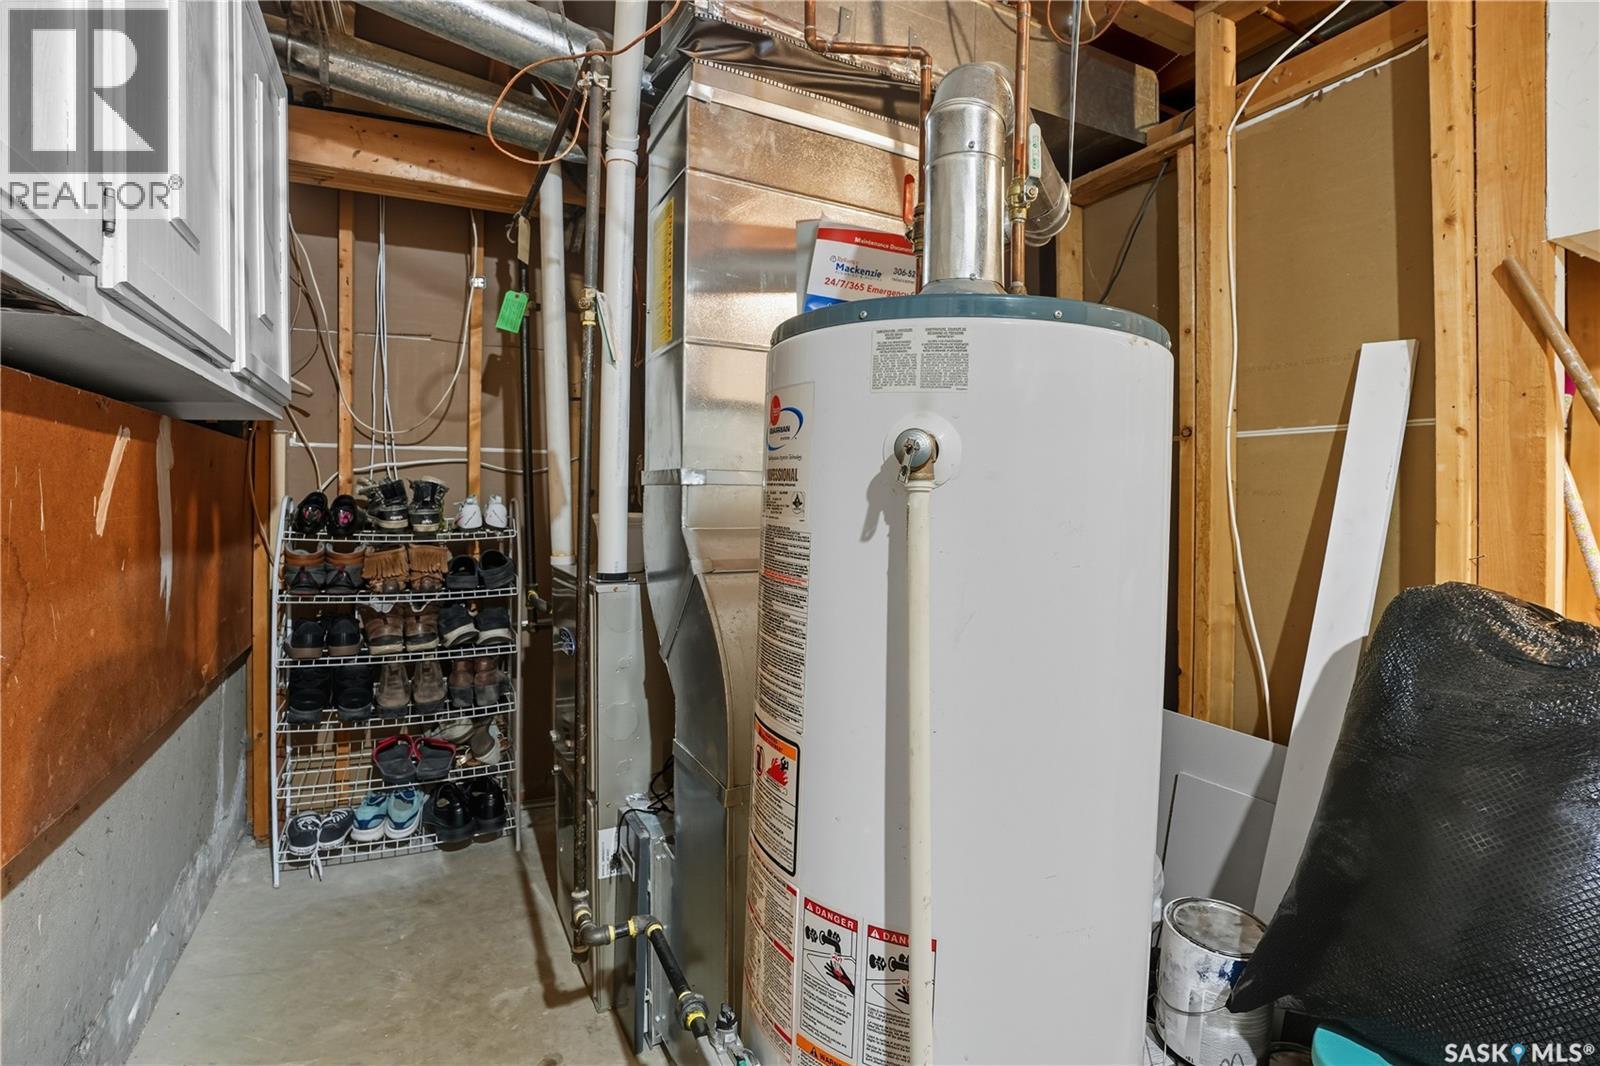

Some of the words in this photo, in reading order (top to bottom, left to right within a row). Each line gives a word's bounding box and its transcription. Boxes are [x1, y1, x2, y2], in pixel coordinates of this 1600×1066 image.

[854, 236, 889, 249] Maintenance
[835, 262, 882, 278] Mackenzie
[824, 277, 865, 291] 24/7/365
[815, 905, 854, 930] DANGER
[882, 931, 910, 945] DAN
